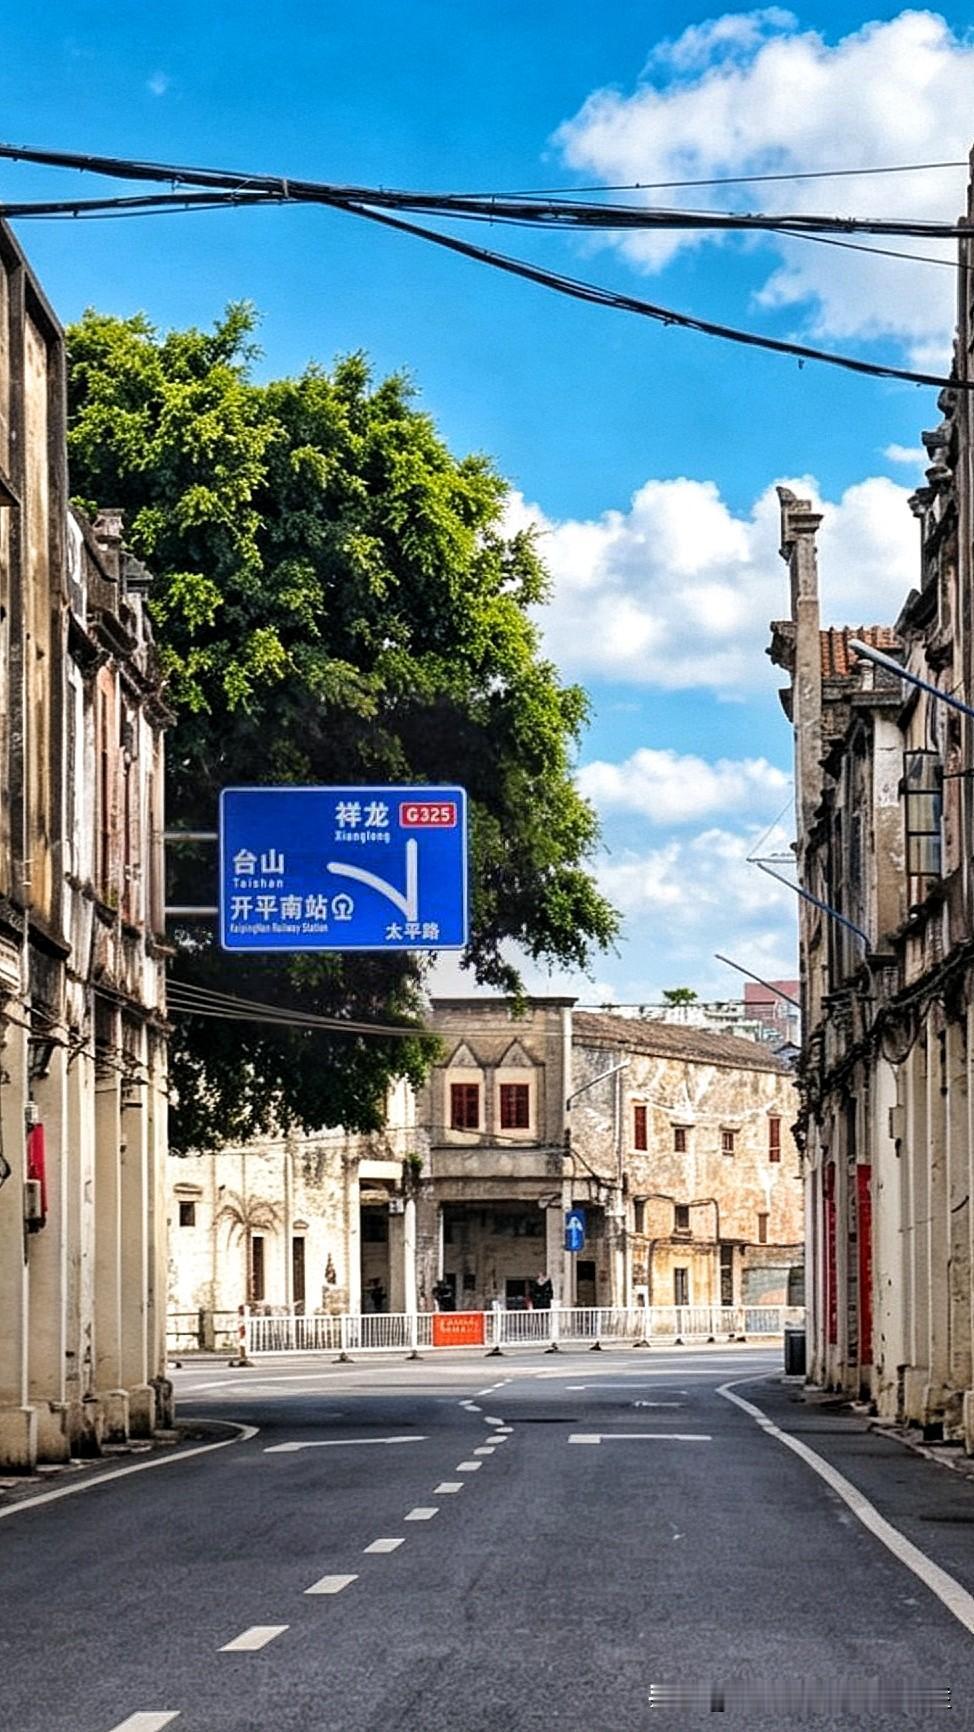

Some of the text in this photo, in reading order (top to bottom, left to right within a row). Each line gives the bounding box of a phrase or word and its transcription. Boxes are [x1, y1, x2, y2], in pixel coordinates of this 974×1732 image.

[335, 801, 389, 828] 祥龙
[406, 807, 450, 822] G325
[335, 830, 391, 844] Xianglong
[233, 848, 285, 875] 台山
[233, 877, 284, 889] Taishan
[230, 895, 328, 921] 开平南站
[386, 922, 440, 940] 太平路
